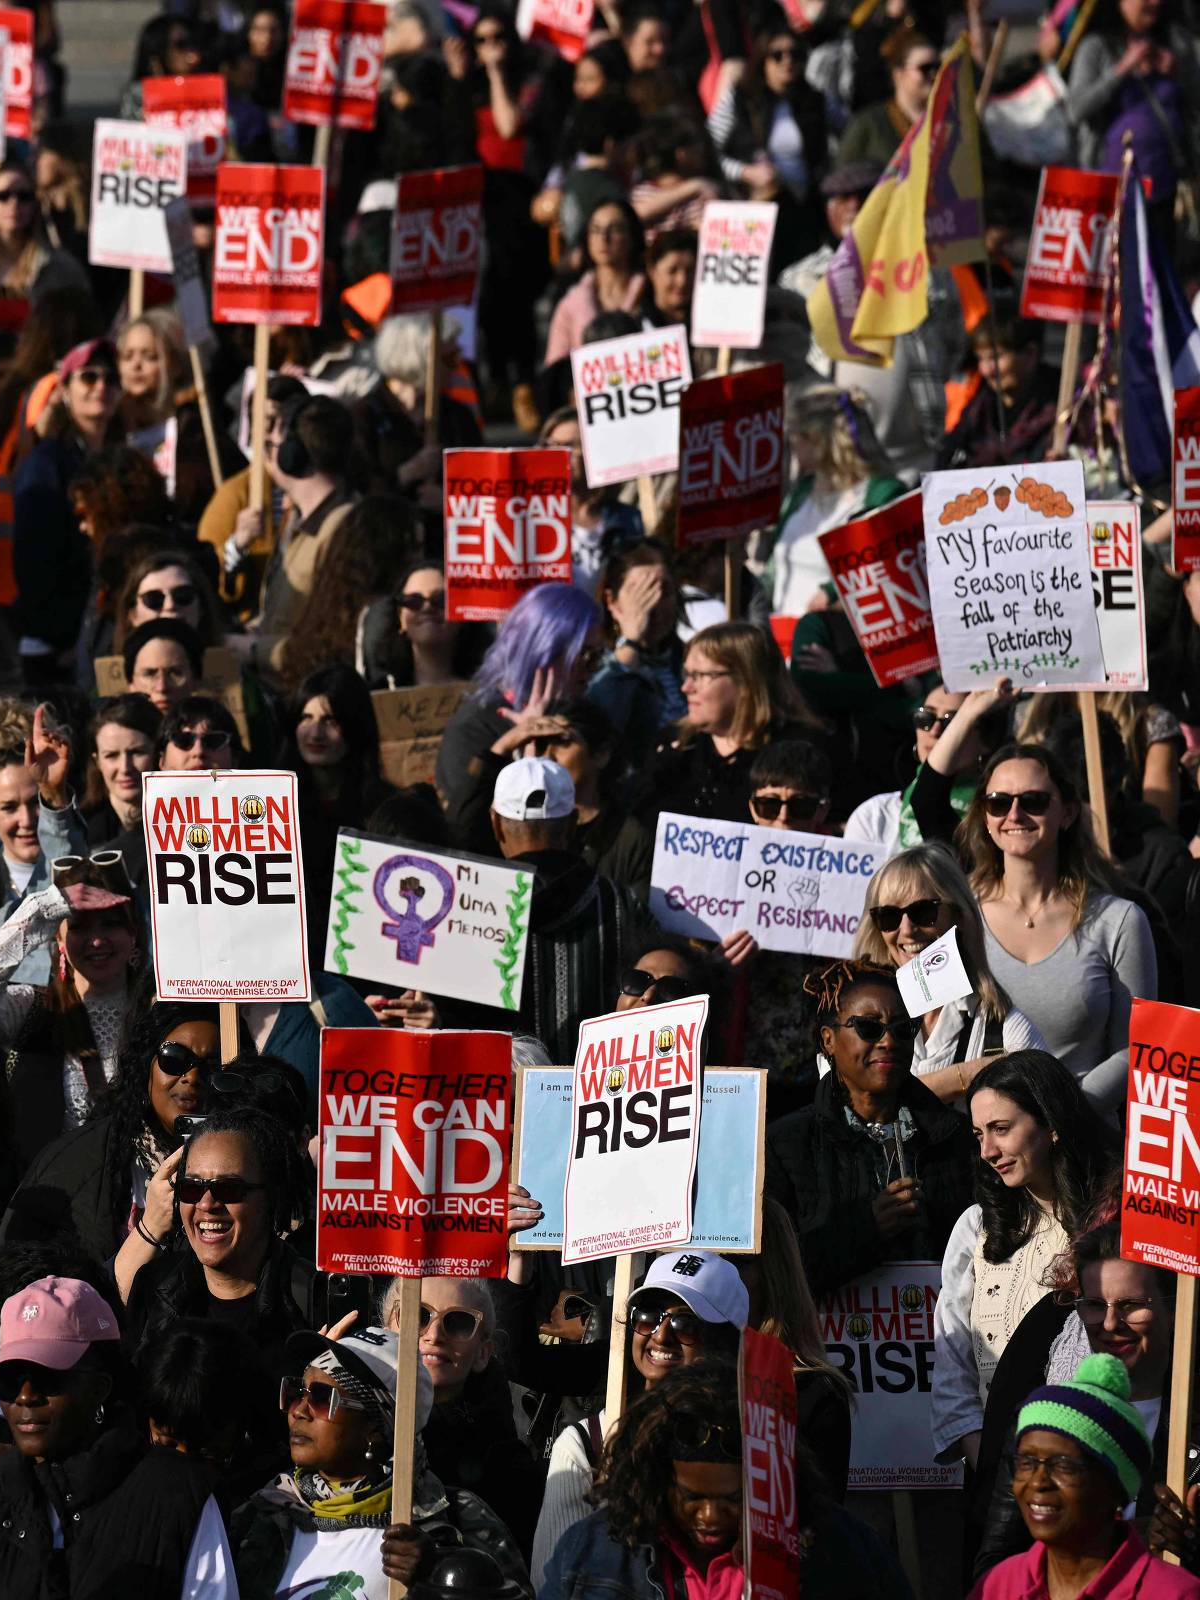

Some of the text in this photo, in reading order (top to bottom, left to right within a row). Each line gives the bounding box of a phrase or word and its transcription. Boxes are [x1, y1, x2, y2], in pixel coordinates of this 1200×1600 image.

[287, 44, 378, 87] END
[218, 206, 321, 230] WE CAN
[1041, 208, 1083, 229] WE
[215, 225, 319, 272] END
[398, 222, 478, 267] END
[703, 254, 760, 285] RISE
[585, 376, 682, 426] RISE
[684, 408, 781, 451] WE CAN
[681, 431, 780, 492] END
[448, 478, 568, 497] TOGETHER
[448, 495, 568, 520] WE CAN
[447, 517, 567, 565] END
[982, 524, 1072, 568] favourite
[448, 563, 569, 579] MALE VIOLENCE
[837, 560, 890, 593] WE
[1031, 570, 1045, 593] is
[1051, 566, 1081, 592] the
[960, 598, 1064, 629] fall of the
[861, 624, 908, 649] MALE
[664, 823, 874, 876] RESPECT EXISTENCE
[155, 853, 296, 906] RISE
[745, 870, 776, 893] OR
[665, 886, 859, 934] EXPECT RESISTANC
[177, 987, 288, 996] MILLIONWOMENRISE.COM
[325, 1069, 507, 1099] TOGETHER
[706, 1085, 740, 1094] Russell
[1133, 1070, 1188, 1114] WE
[326, 1095, 504, 1131] WE CAN
[575, 1085, 692, 1159] RISE
[1128, 1101, 1200, 1182] EN
[322, 1125, 503, 1195] END
[1127, 1174, 1177, 1204] MALE
[322, 1194, 504, 1216] MALE VIOLENCE
[1124, 1195, 1197, 1227] AGAINST
[322, 1212, 504, 1233] AGAINST WOMEN
[572, 1220, 681, 1248] INTERNATIONAL WOMEN'S DAY
[579, 1231, 672, 1255] MILLIONWOMENRISE.COM
[708, 1235, 741, 1243] violence.
[332, 1253, 492, 1268] INTERNATIONAL WOMEN'S DAY
[344, 1262, 480, 1276] MILLIONWOMENRISE.COM
[940, 1467, 957, 1475] DAY
